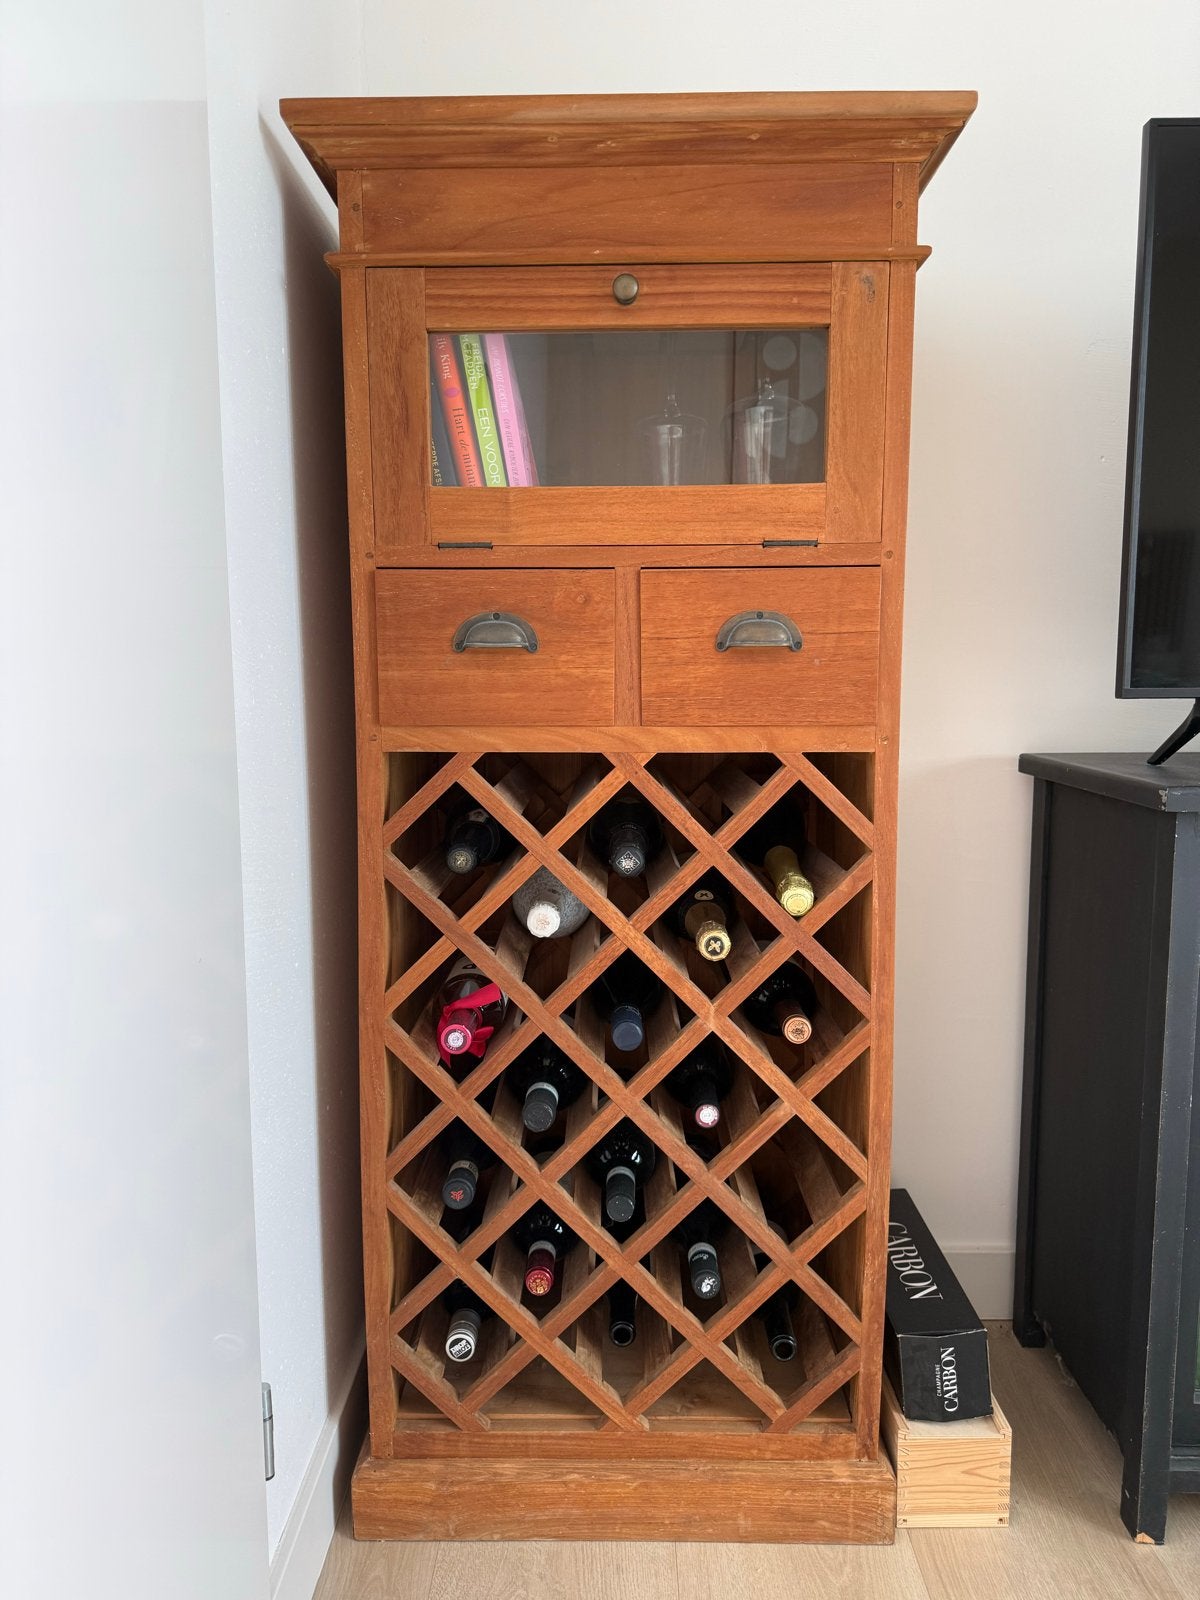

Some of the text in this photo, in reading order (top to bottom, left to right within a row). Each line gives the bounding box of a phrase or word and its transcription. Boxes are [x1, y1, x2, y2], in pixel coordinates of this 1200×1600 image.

[440, 354, 453, 379] King
[462, 334, 478, 390] MCFADDEN
[472, 343, 485, 379] FREIDA
[452, 407, 465, 435] Hart
[459, 440, 470, 451] de
[478, 408, 501, 485] EEN VOOR
[888, 1221, 944, 1300] CARBON
[940, 1347, 959, 1413] CARBON
